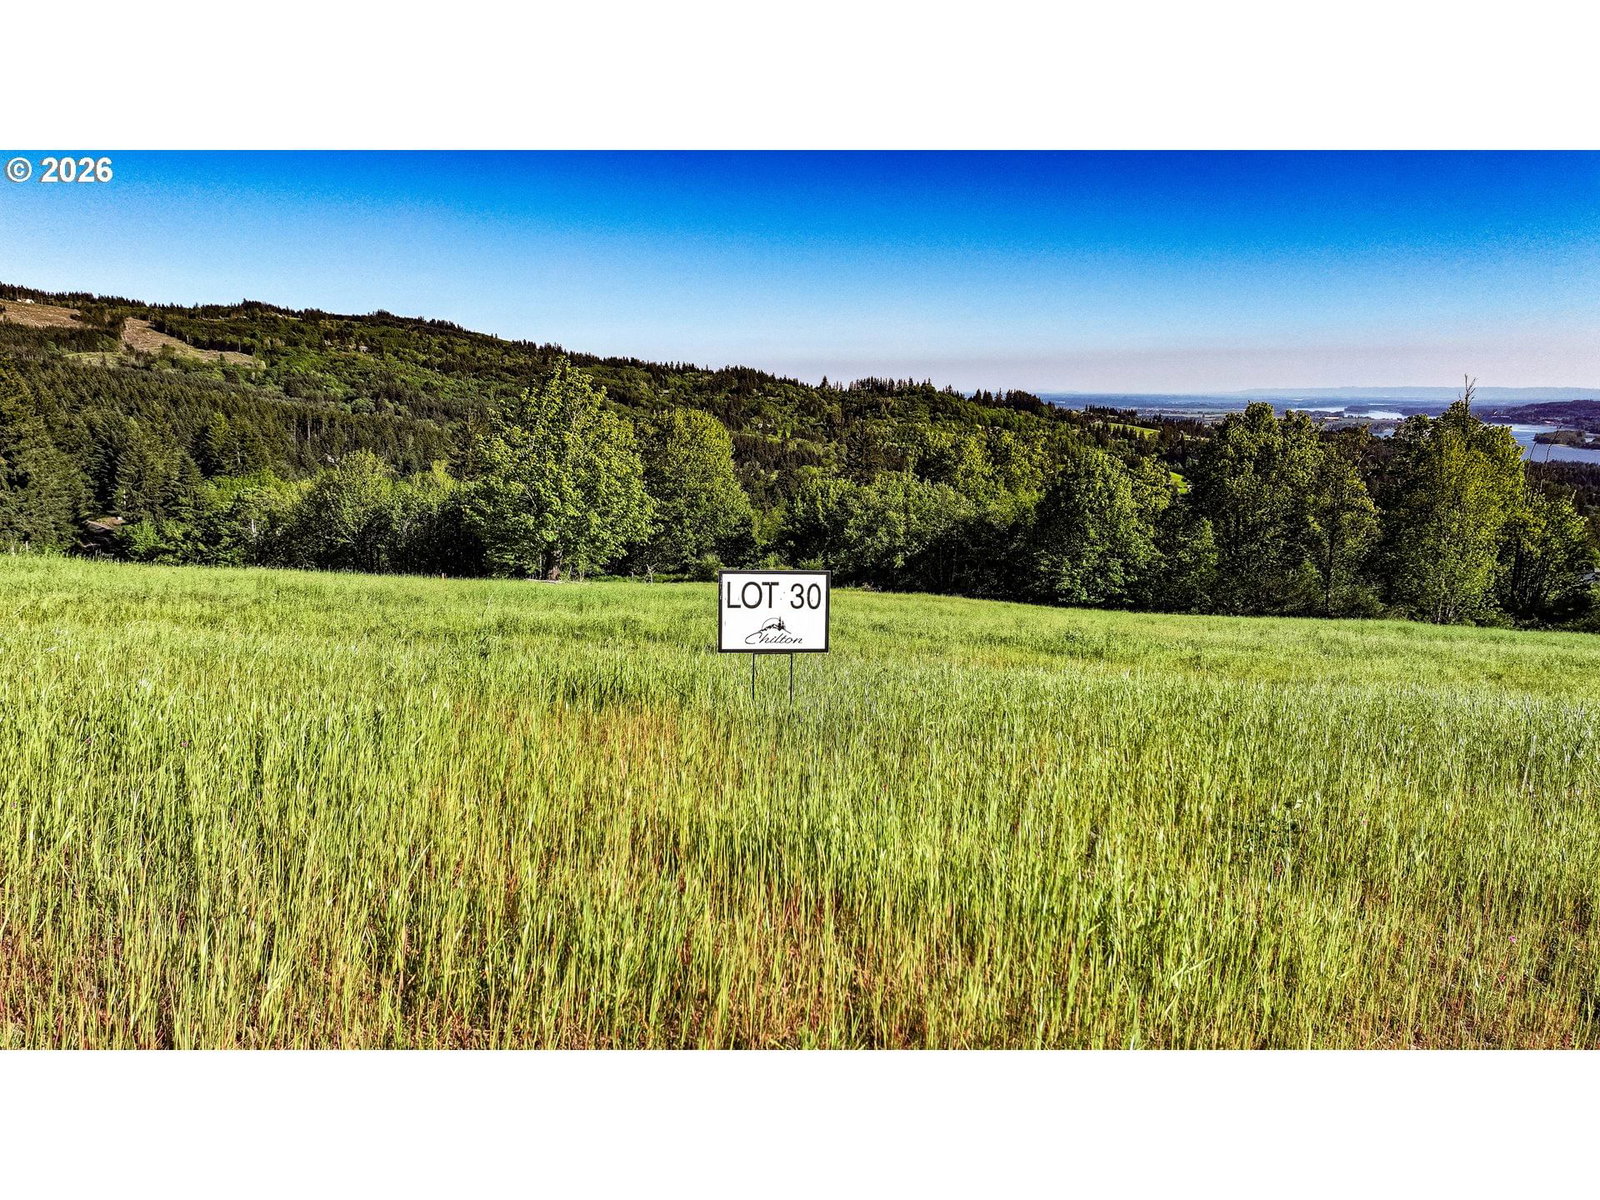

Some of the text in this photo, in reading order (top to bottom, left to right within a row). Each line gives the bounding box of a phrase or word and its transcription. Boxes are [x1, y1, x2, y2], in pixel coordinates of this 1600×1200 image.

[727, 581, 821, 610] LOT 30
[744, 631, 803, 645] Chilton
